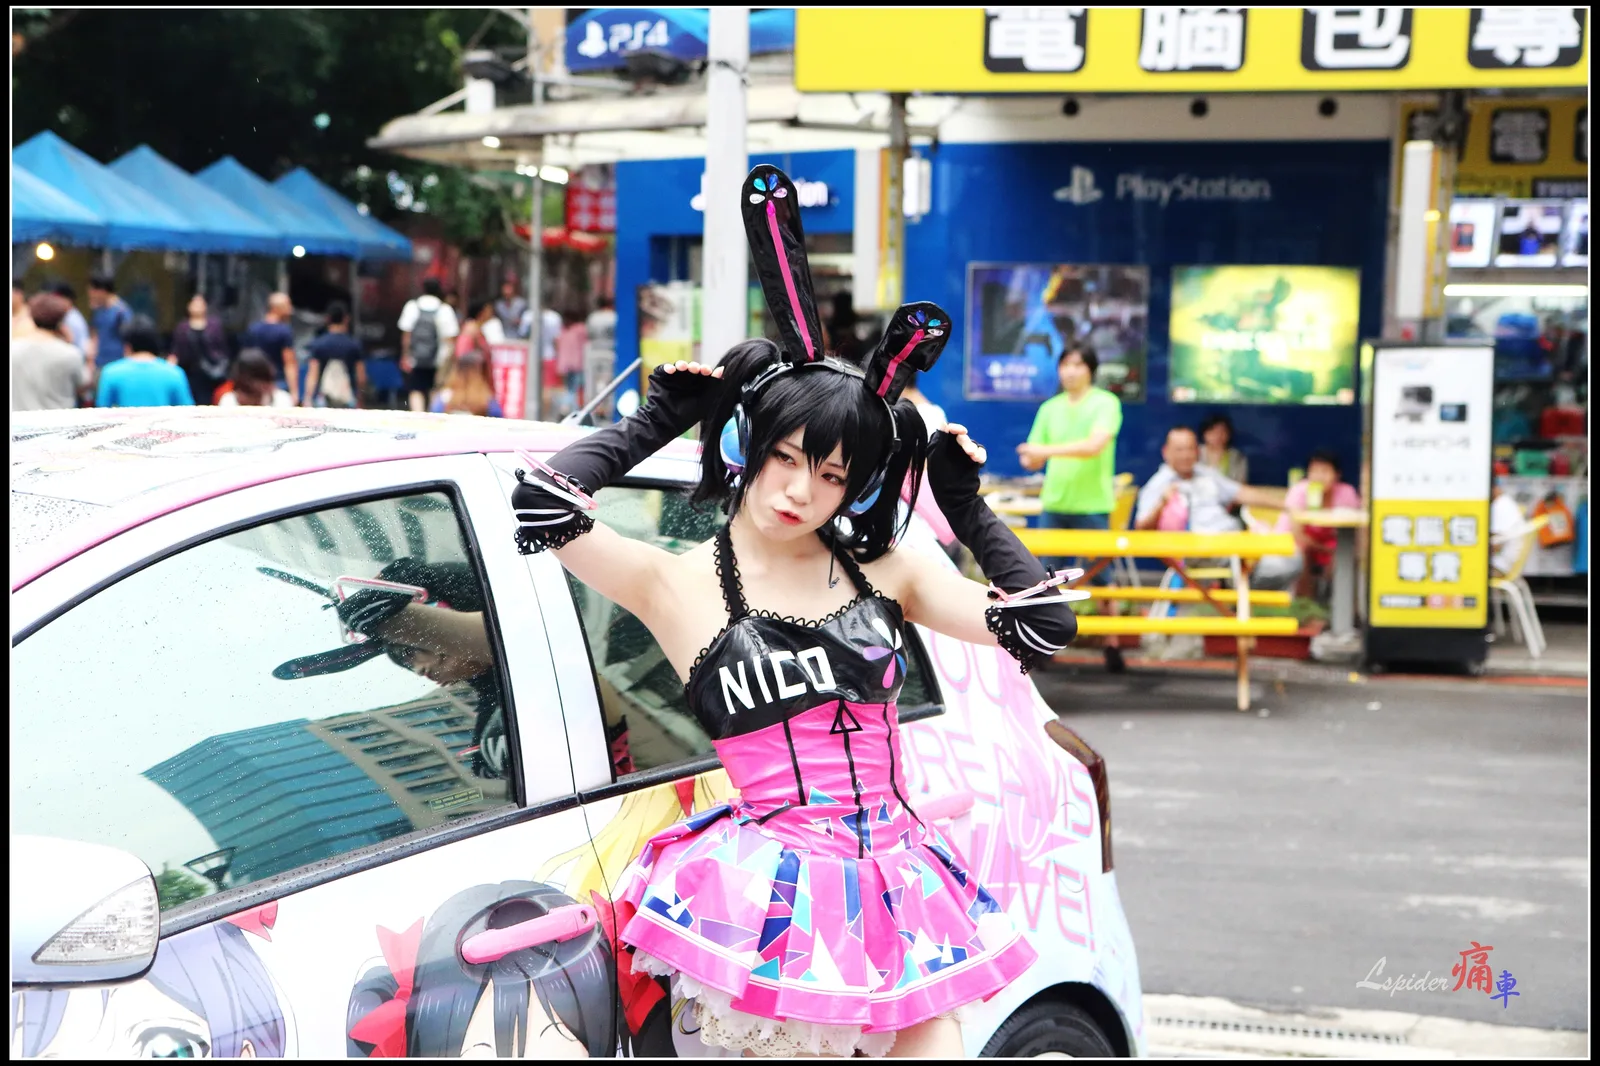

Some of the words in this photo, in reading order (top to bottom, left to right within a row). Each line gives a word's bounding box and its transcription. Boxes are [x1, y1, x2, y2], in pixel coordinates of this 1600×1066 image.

[608, 20, 669, 52] PS4
[1115, 172, 1271, 209] PlayStation
[719, 646, 837, 715] NICO
